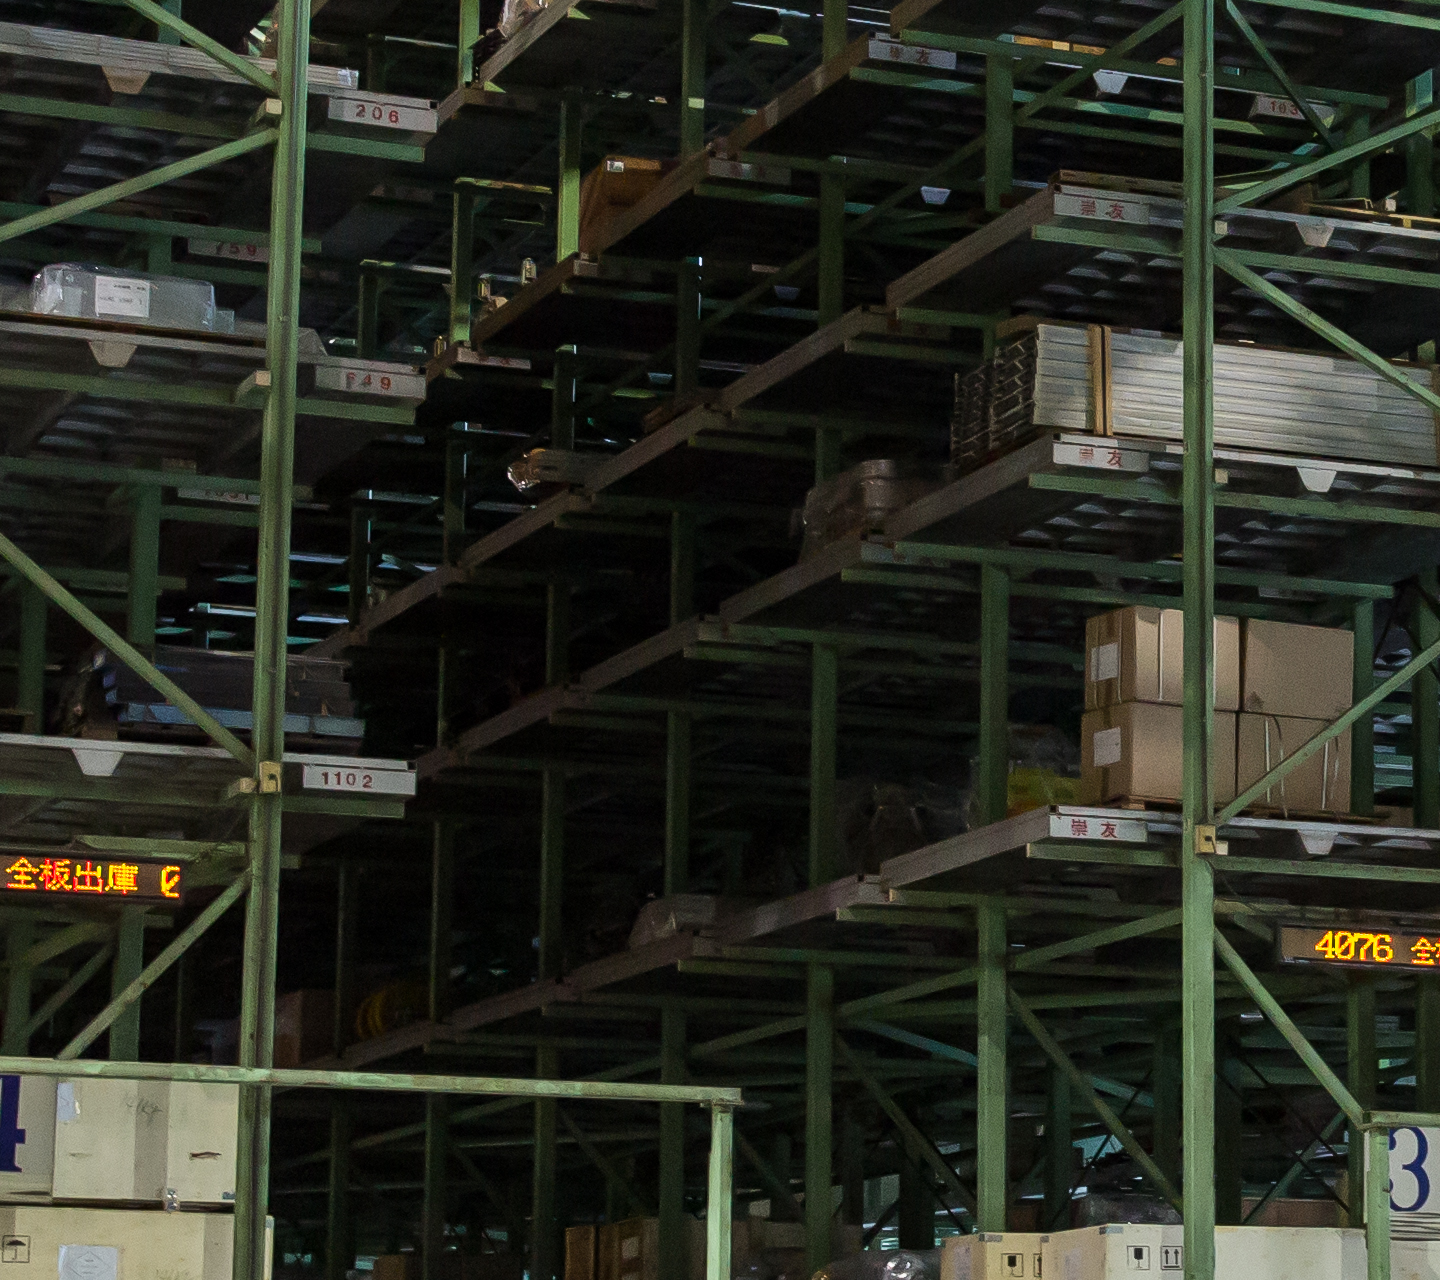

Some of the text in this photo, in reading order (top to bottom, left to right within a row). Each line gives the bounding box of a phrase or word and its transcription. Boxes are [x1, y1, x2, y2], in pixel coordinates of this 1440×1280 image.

[354, 103, 401, 125] 206
[320, 770, 374, 790] 1102
[1071, 817, 1118, 840] 崇友
[5, 856, 139, 896] 全板出庫
[1314, 930, 1394, 964] 4076
[1388, 1125, 1431, 1213] 3
